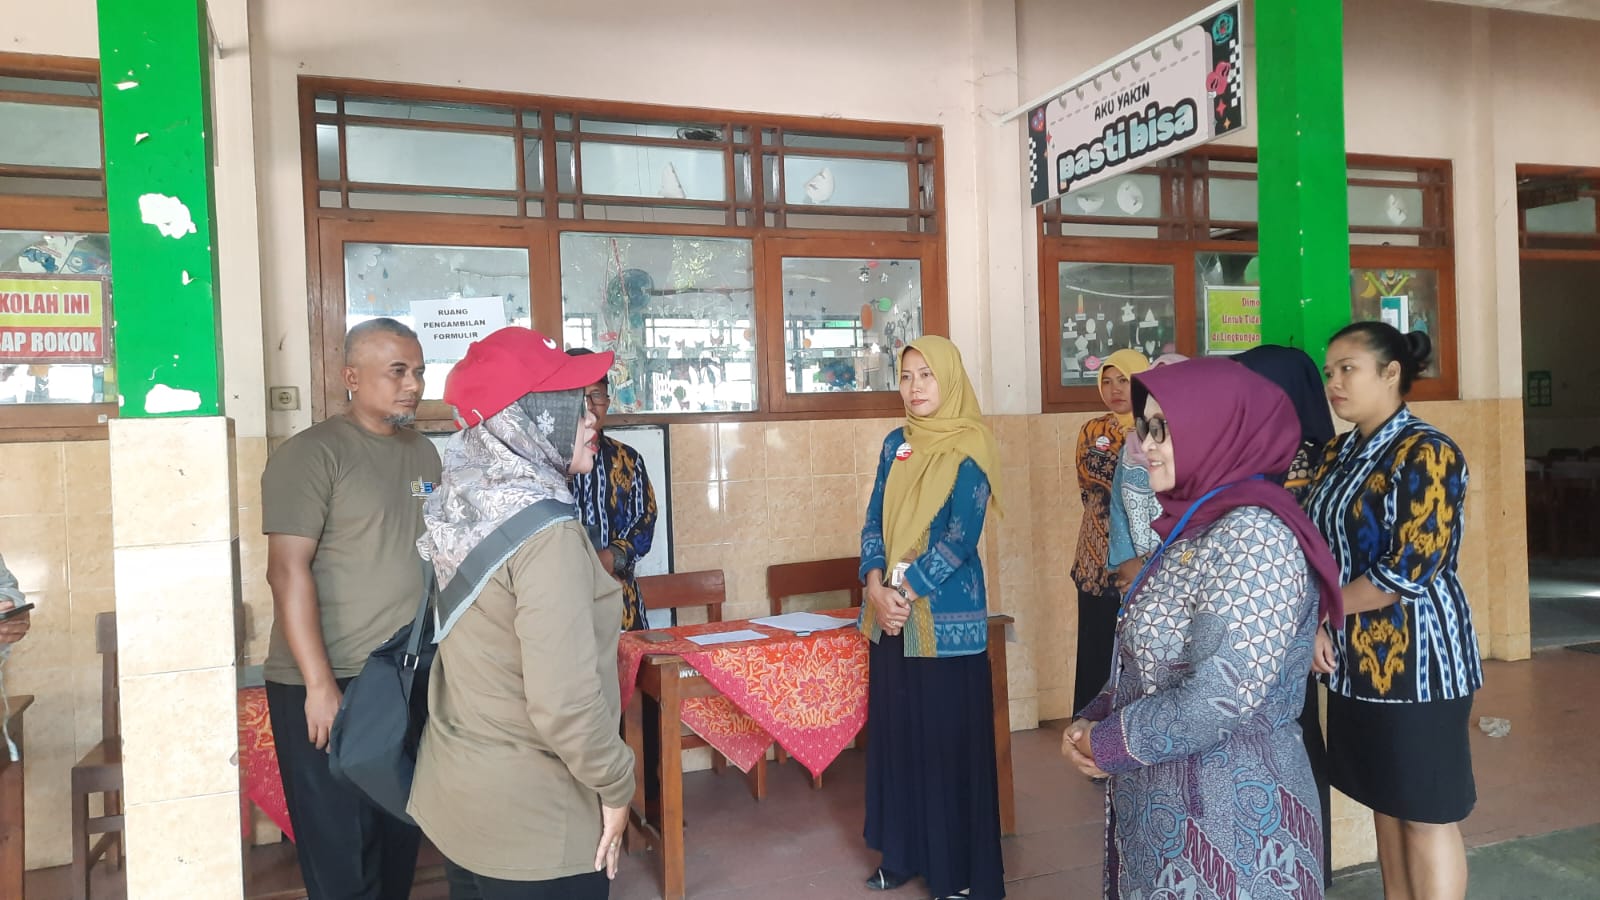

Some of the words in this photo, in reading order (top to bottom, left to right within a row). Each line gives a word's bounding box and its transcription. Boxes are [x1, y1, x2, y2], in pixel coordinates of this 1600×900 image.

[1094, 99, 1115, 122] AKU
[1117, 81, 1150, 112] YAKIN
[1058, 120, 1126, 191] pasti
[1130, 101, 1195, 155] bisa
[63, 294, 90, 315] INI
[438, 308, 469, 316] RUANG
[423, 319, 486, 329] PENGAMBILAN
[0, 331, 27, 353] AP
[31, 331, 97, 353] ROKOK
[433, 331, 479, 340] FORMULIR
